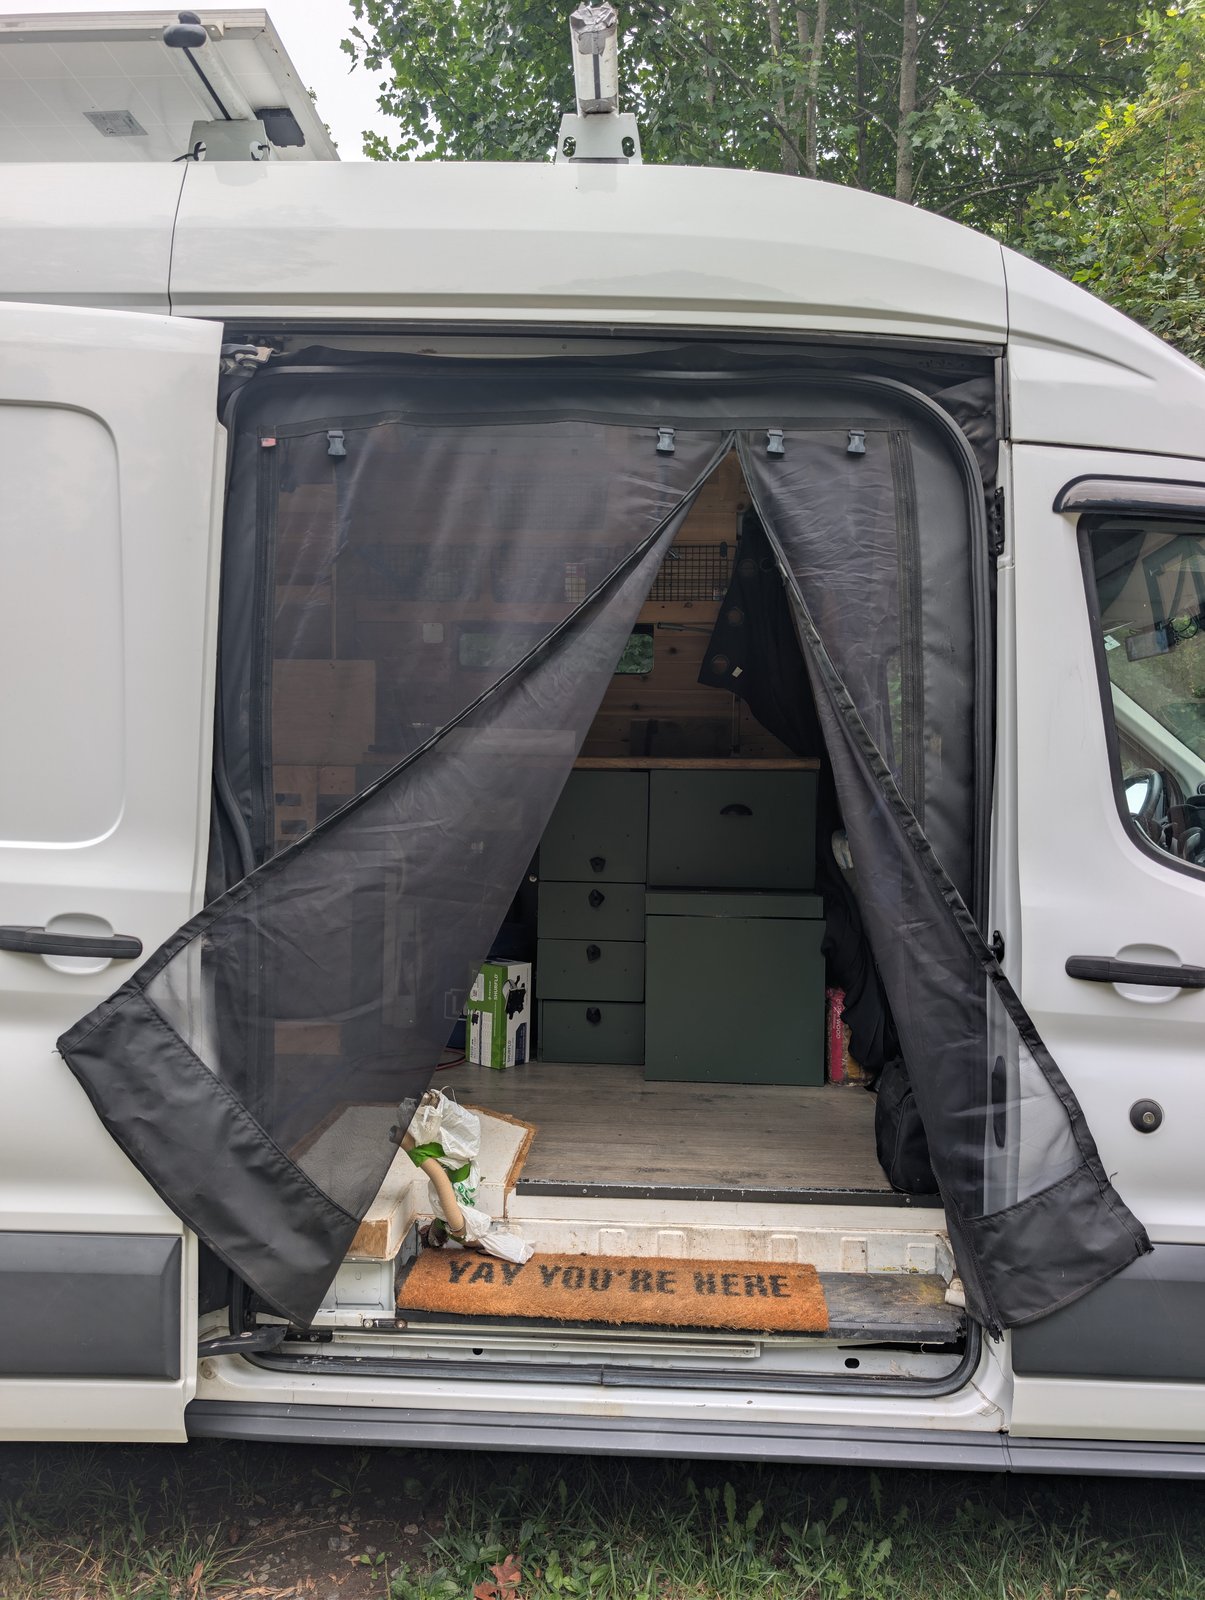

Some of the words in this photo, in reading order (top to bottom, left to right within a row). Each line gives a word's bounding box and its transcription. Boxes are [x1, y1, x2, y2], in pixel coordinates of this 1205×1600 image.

[449, 1260, 525, 1286] YAY
[539, 1264, 676, 1294] YOU'RE
[693, 1271, 791, 1298] HERE
